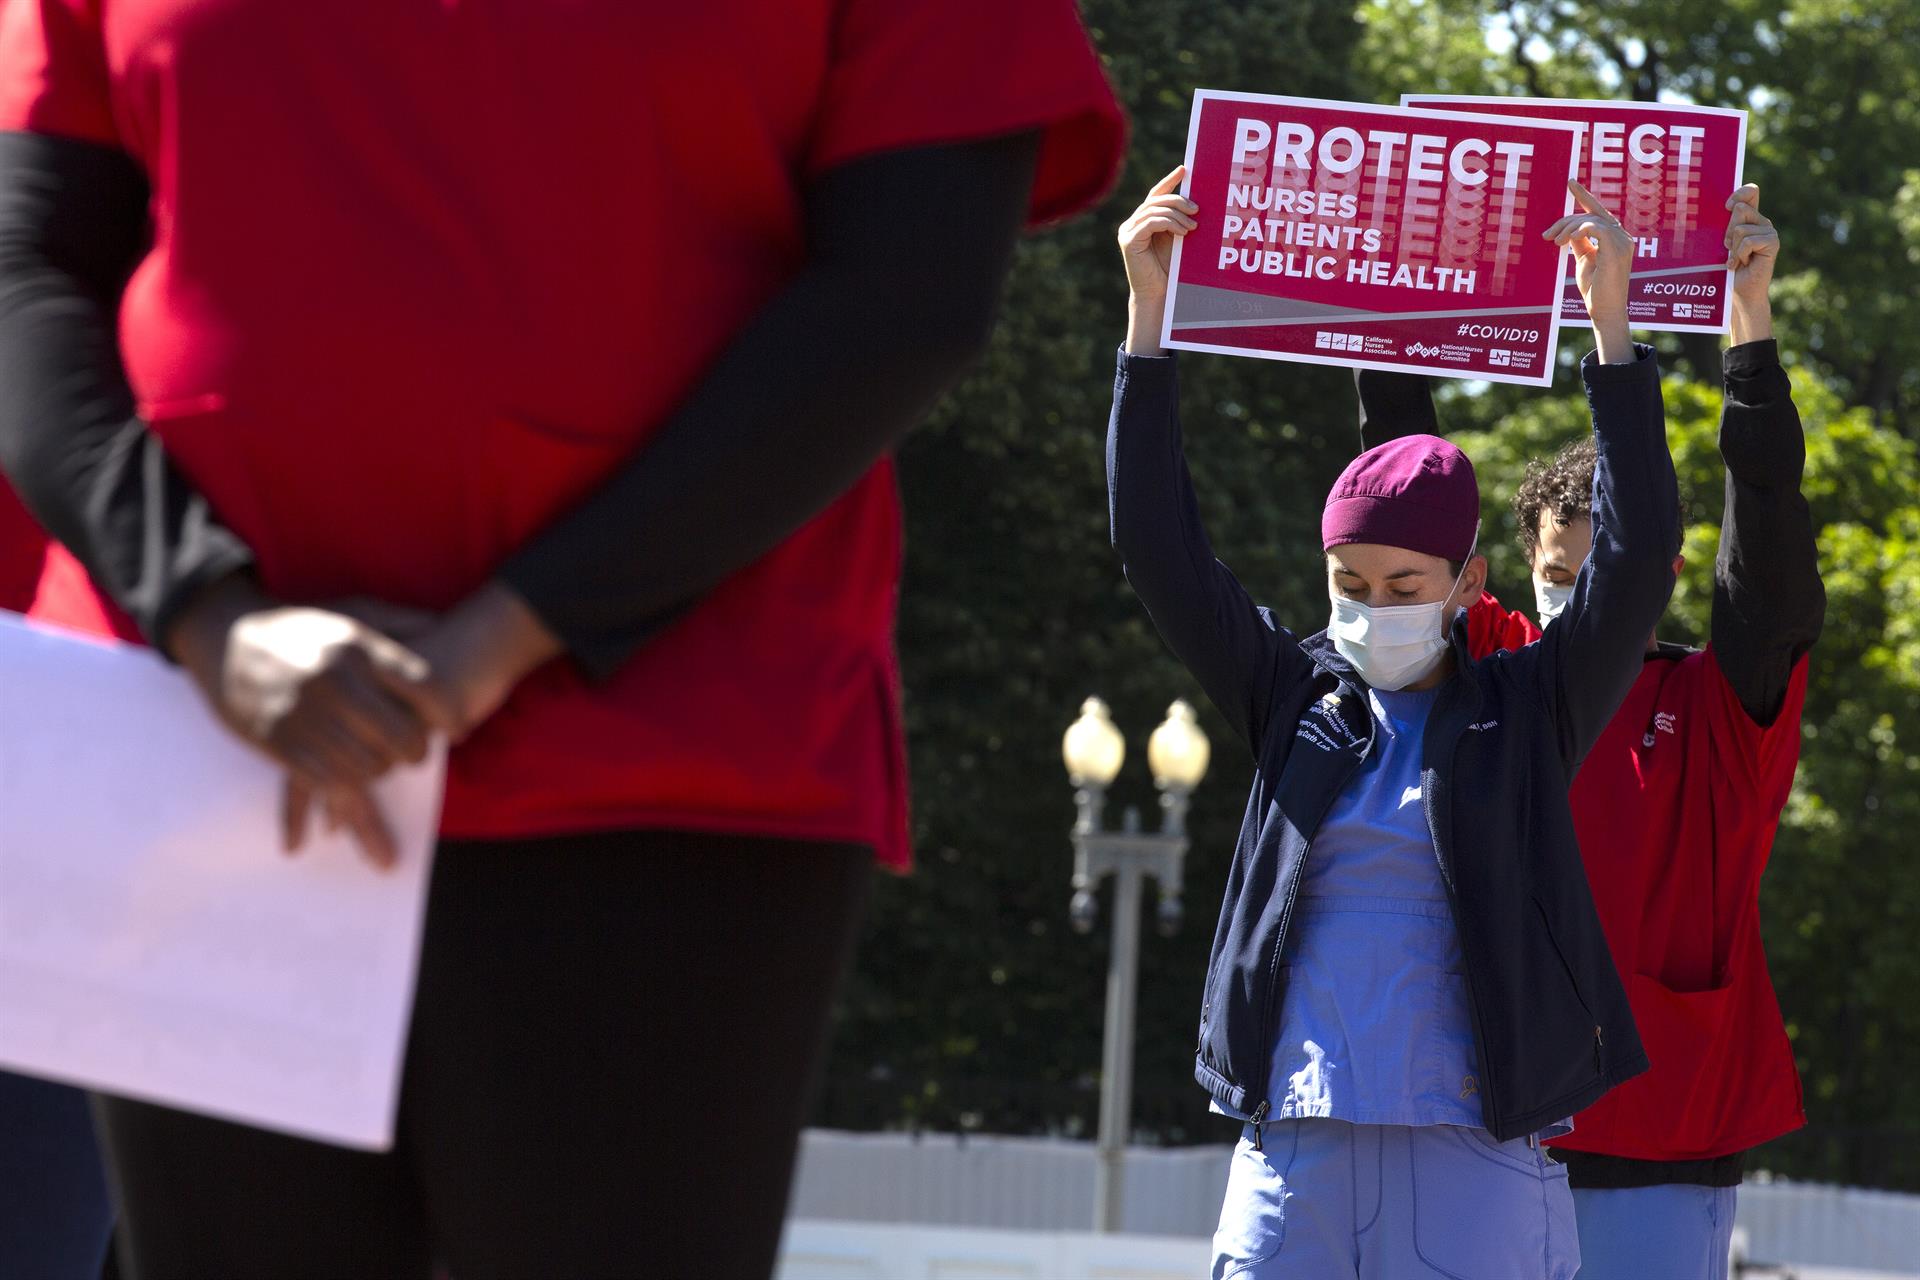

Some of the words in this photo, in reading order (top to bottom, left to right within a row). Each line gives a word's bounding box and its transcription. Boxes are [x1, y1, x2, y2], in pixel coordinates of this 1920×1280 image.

[1232, 118, 1534, 188] PROTECT
[1582, 121, 1705, 165] ECT
[1226, 183, 1358, 219] NURSES
[1222, 215, 1382, 252] PATIENTS
[1218, 246, 1337, 280] PUBLIC
[1346, 259, 1476, 294] HEALTH
[1643, 283, 1717, 297] #COVID19
[1365, 336, 1393, 344] California
[1457, 323, 1539, 343] #COVID19
[1363, 347, 1397, 356] Association
[1440, 349, 1471, 358] Organizing
[1512, 350, 1537, 358] National
[1330, 706, 1357, 742] Washingto
